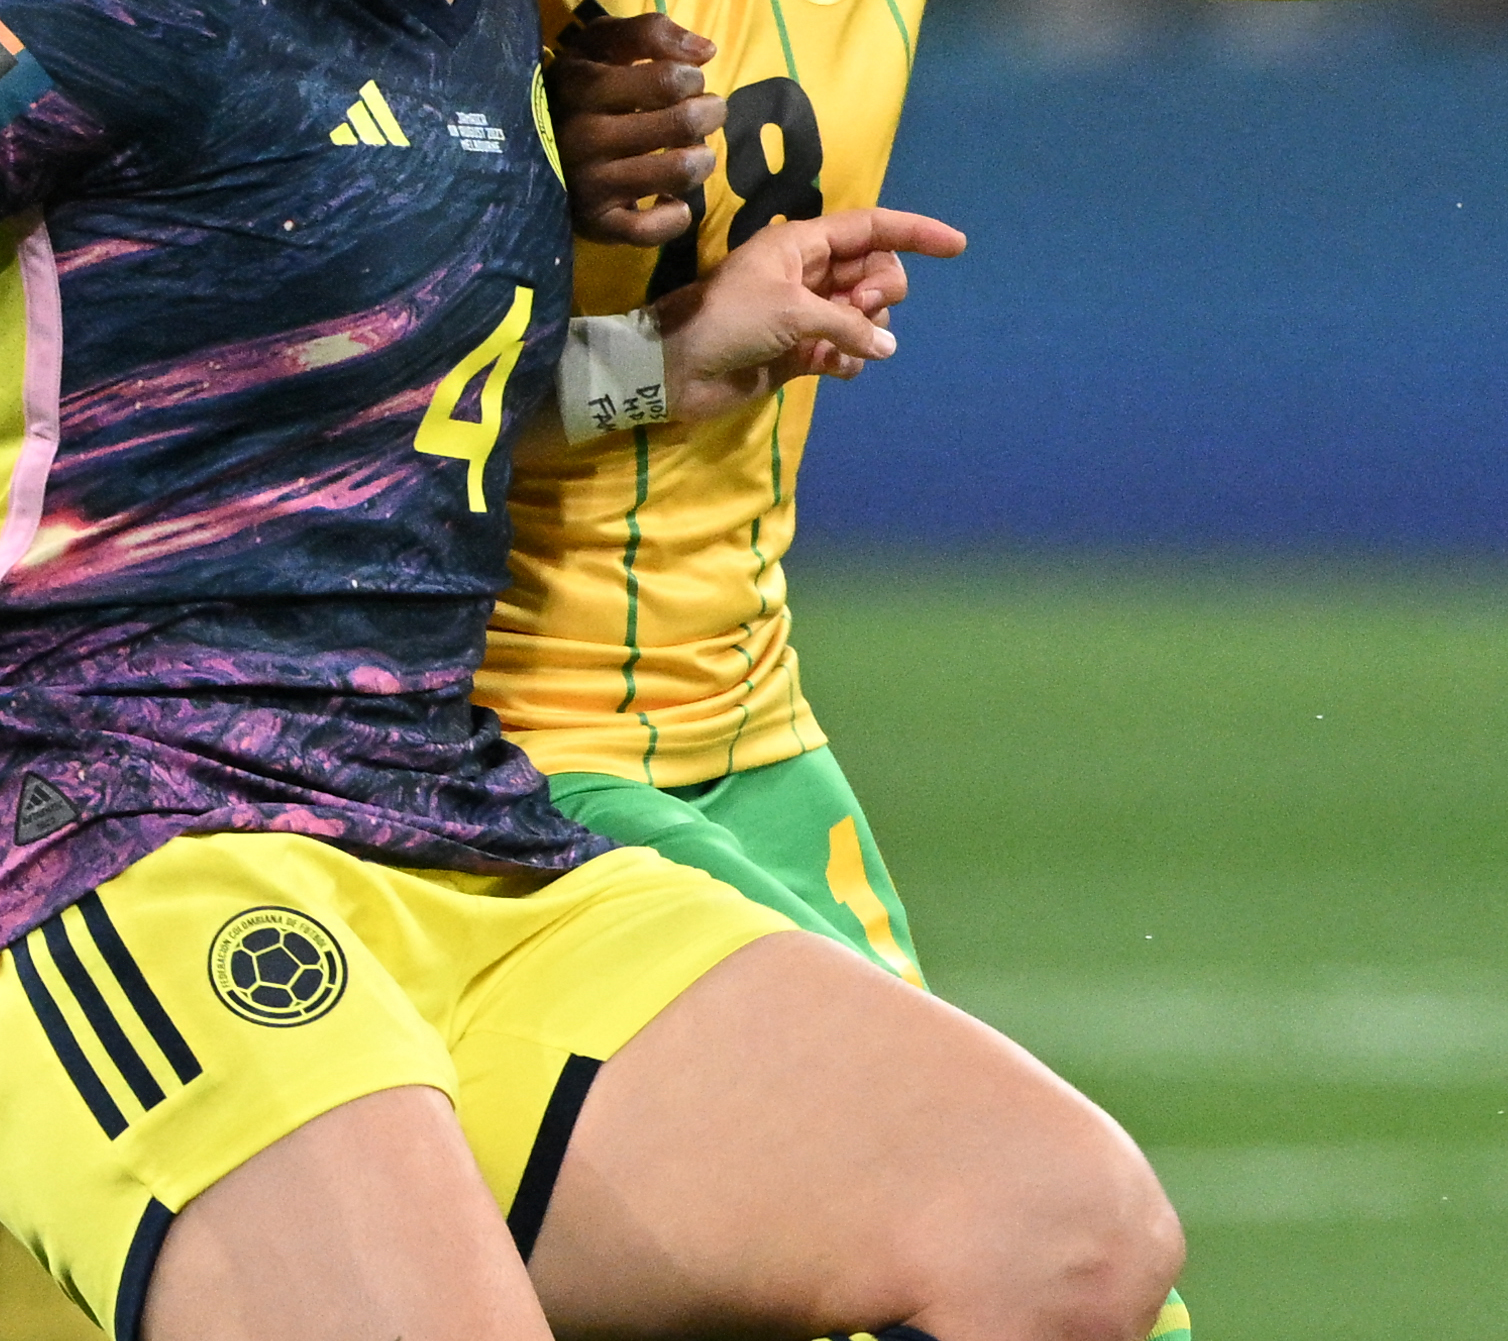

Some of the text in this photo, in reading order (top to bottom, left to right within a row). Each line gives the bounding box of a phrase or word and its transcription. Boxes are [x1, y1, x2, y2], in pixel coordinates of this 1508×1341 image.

[413, 284, 534, 513] 4
[229, 915, 283, 939] COLOMBIANA
[286, 917, 297, 928] DE
